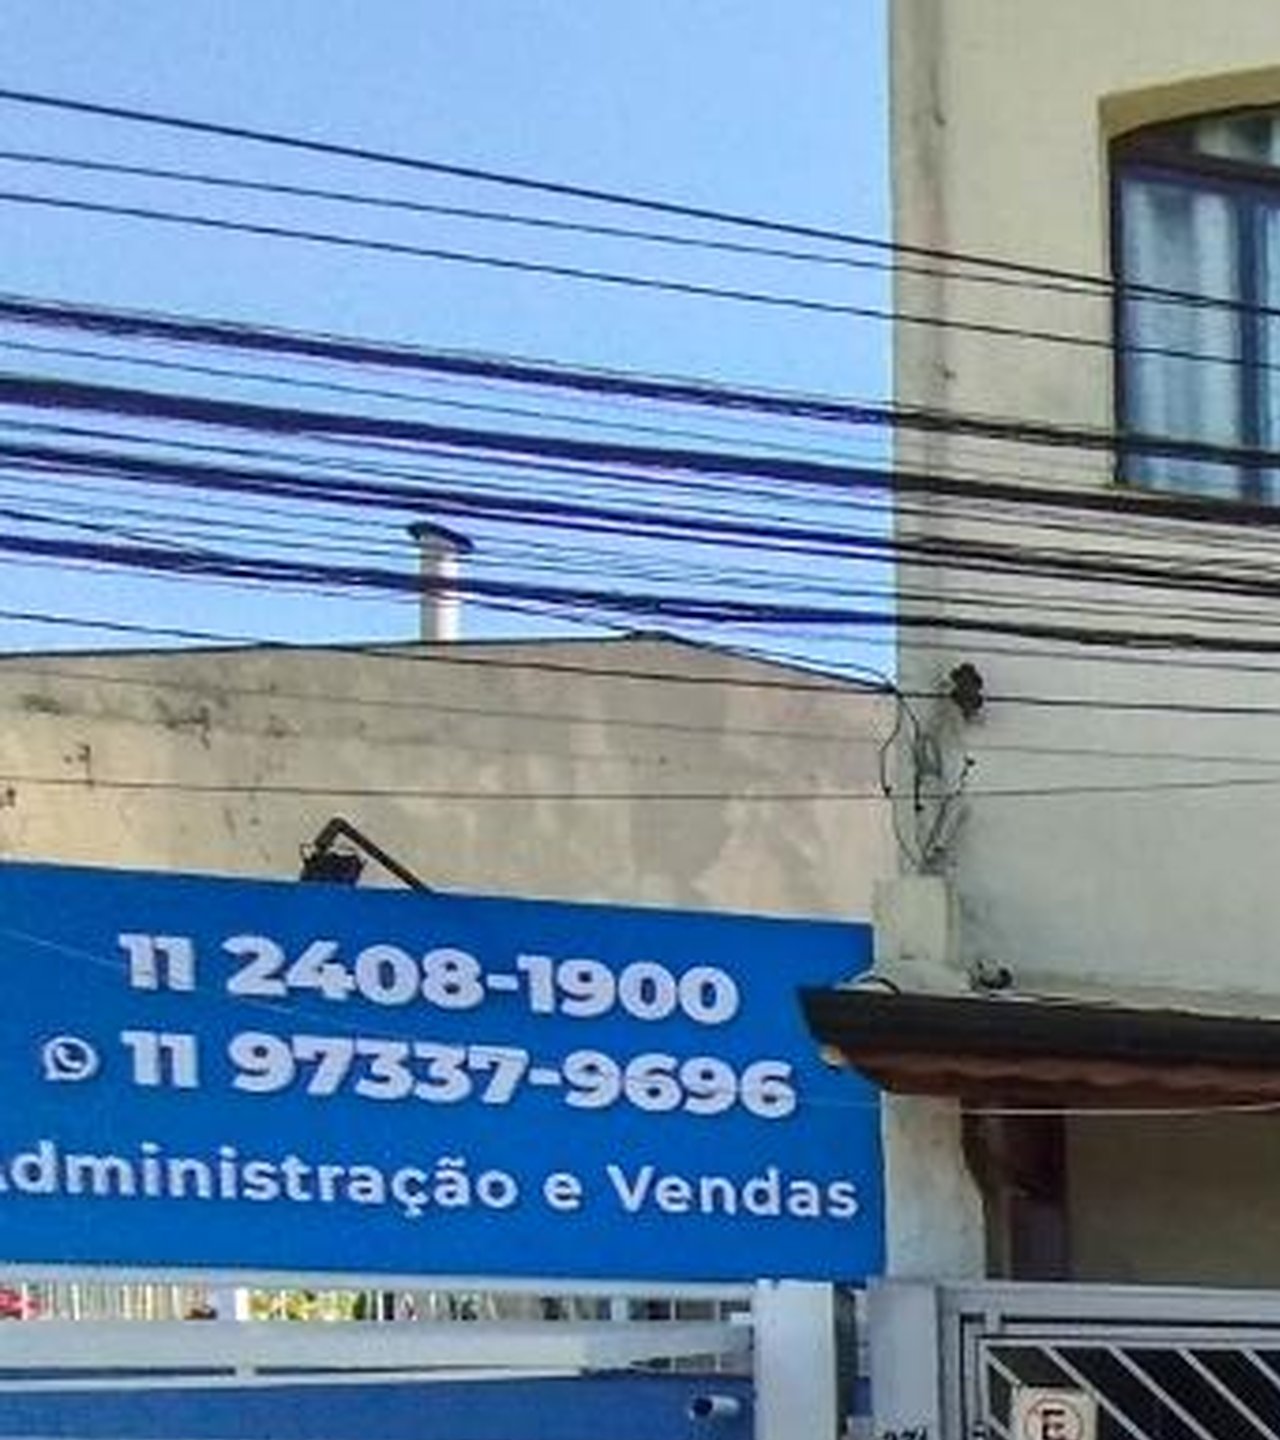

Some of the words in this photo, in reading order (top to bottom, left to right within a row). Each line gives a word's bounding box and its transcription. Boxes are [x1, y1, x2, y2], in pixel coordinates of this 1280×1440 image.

[120, 934, 194, 991] 11
[224, 937, 740, 1024] 2408-1900
[124, 1031, 197, 1087] 11
[229, 1032, 796, 1118] 97337-9696
[0, 1139, 516, 1218] dministração
[544, 1172, 582, 1210] e
[607, 1164, 859, 1217] Vendas
